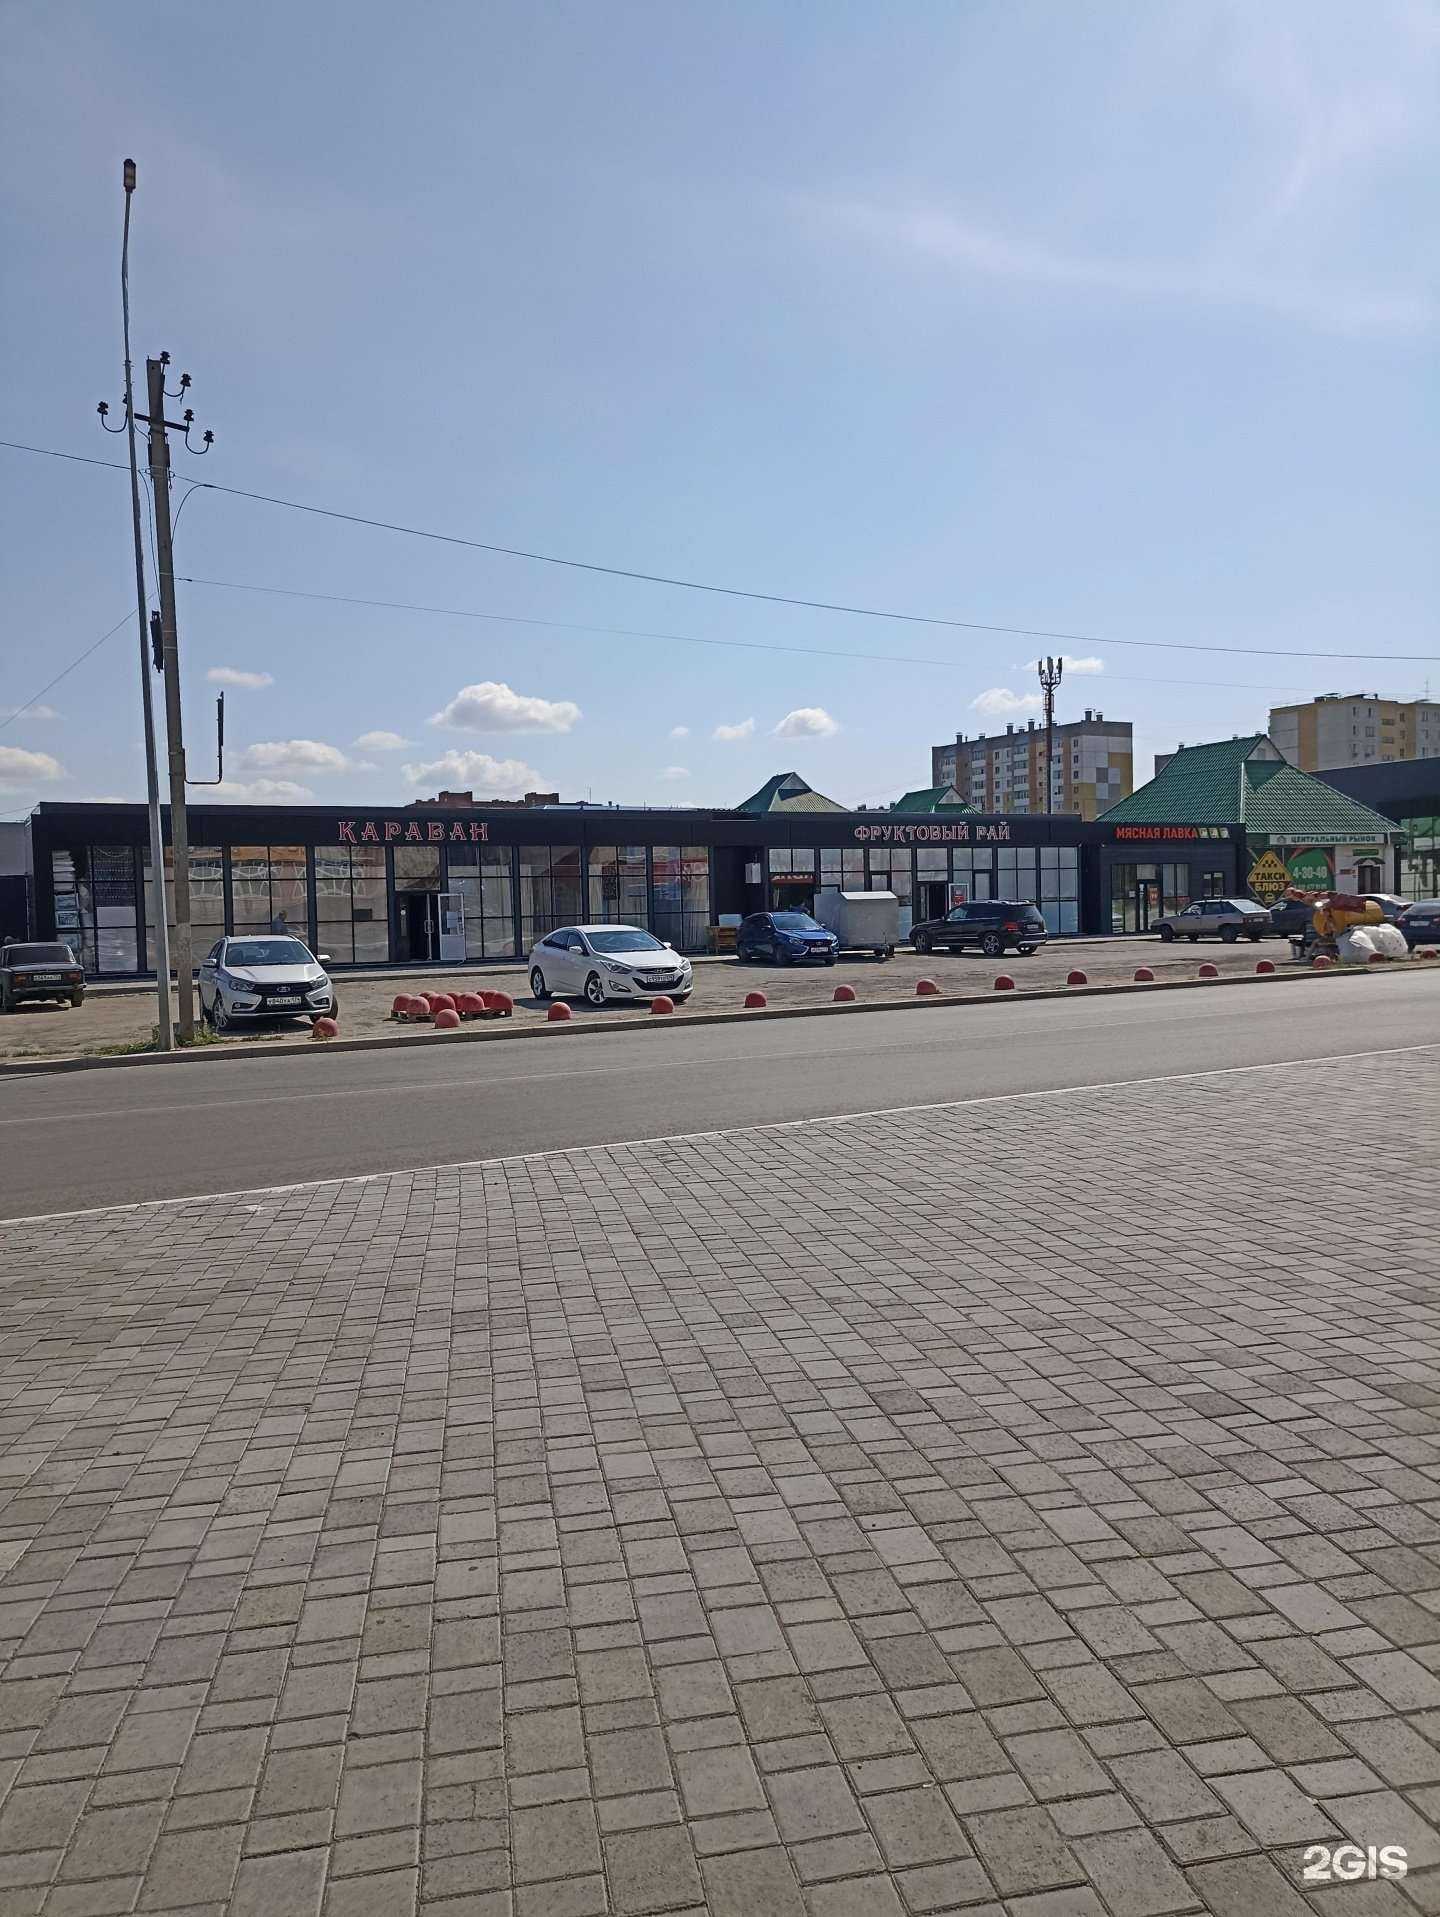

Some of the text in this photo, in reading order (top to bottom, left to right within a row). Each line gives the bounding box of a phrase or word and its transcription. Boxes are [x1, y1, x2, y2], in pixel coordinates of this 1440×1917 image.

[337, 821, 489, 844] КАРАВАН
[854, 821, 1011, 843] ФРУКТОВЫЙ РАЙ
[1115, 827, 1198, 839] МЯСНАЯ ЛАВКА
[1253, 872, 1285, 881] ТАКСИ
[1254, 882, 1285, 892] БЛЮЗ
